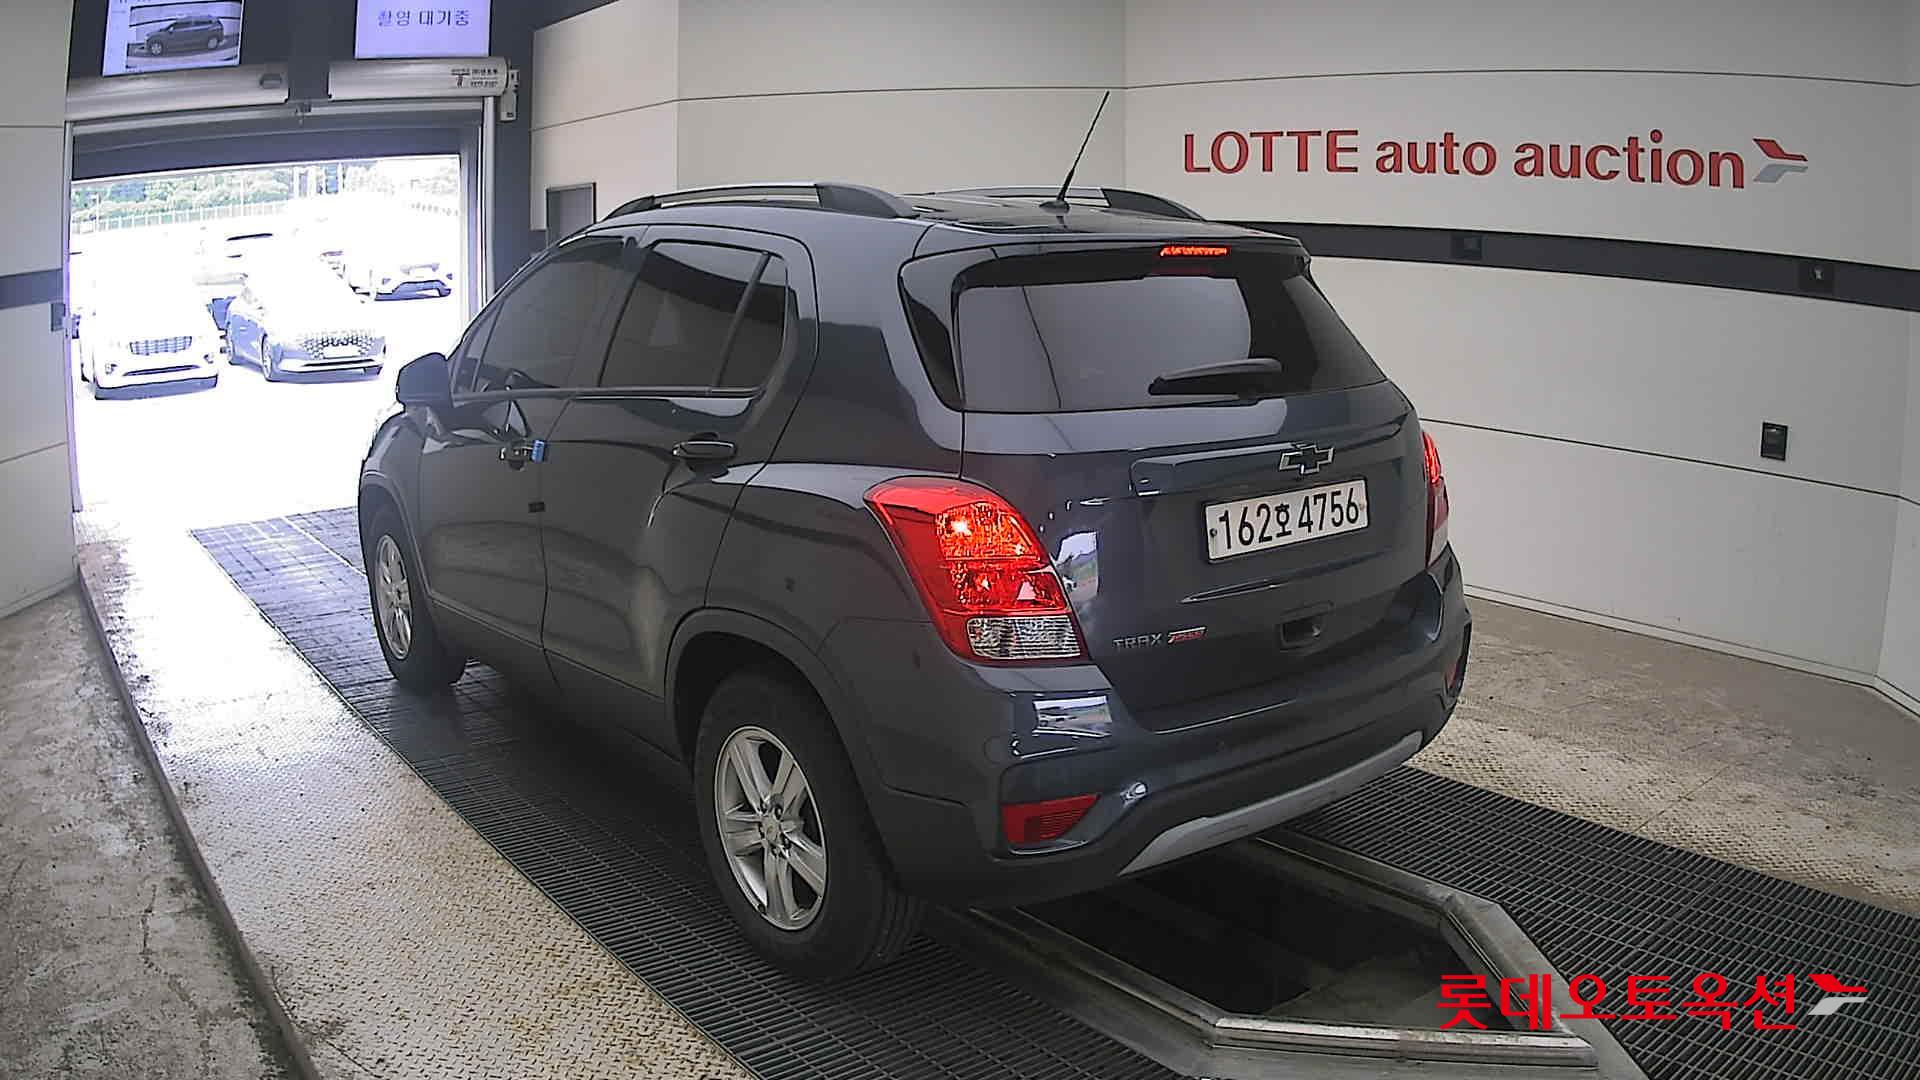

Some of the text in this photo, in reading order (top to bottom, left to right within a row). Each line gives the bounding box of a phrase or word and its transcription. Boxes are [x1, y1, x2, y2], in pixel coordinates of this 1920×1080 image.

[1184, 128, 1746, 190] LOTTE auto auction
[1298, 486, 1361, 534] 4756
[1111, 631, 1163, 649] TRAX
